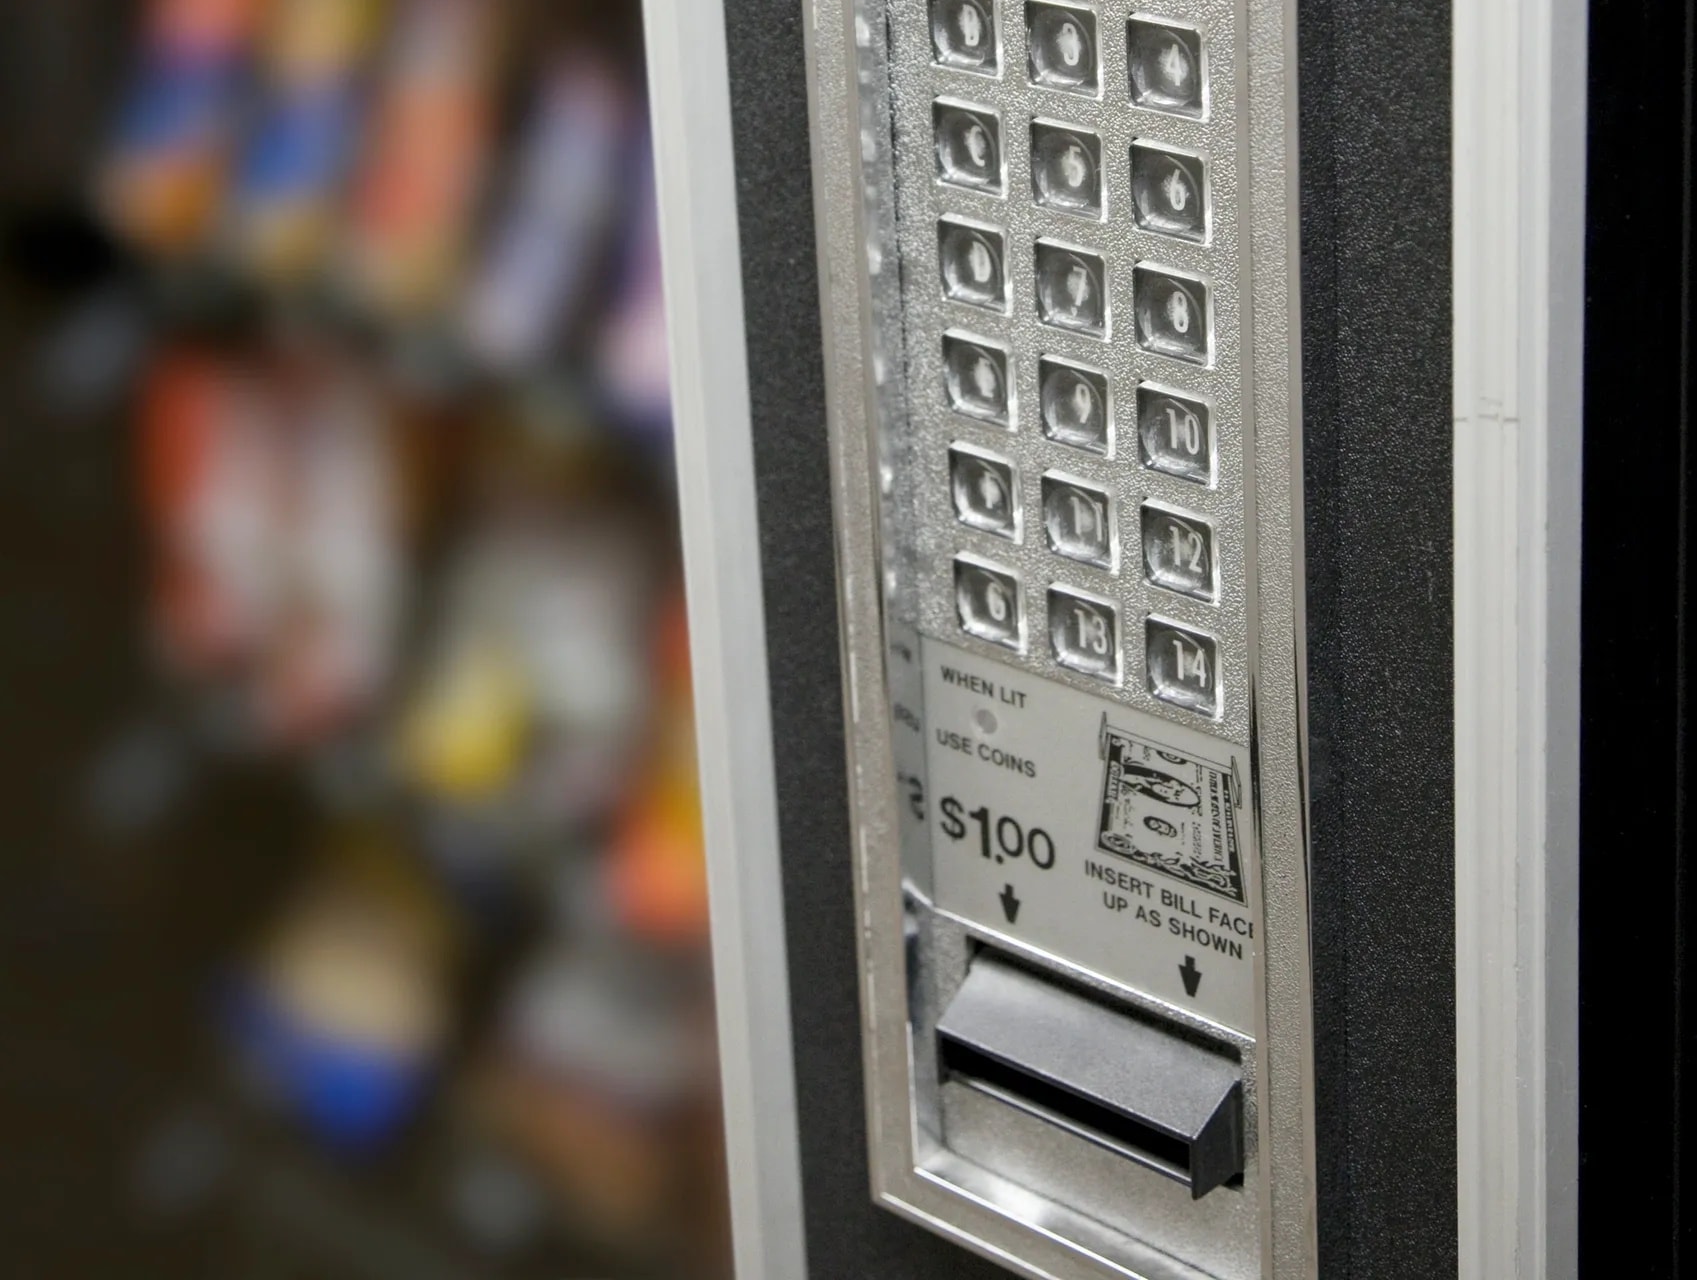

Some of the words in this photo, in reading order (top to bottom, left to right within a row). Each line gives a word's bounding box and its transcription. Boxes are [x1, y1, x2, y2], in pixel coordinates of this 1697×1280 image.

[1166, 43, 1186, 87] 4
[1068, 145, 1086, 188] 5
[1168, 168, 1186, 211] 6
[1171, 291, 1189, 333] 8
[1075, 383, 1092, 423] 9
[1166, 408, 1200, 455] 10
[1070, 496, 1104, 542] 11
[1169, 525, 1203, 574] 12
[1073, 608, 1108, 655] 13
[1173, 639, 1207, 688] 14
[940, 665, 995, 699] WHEN
[999, 687, 1027, 710] LIT
[936, 729, 973, 756] USE
[977, 742, 1037, 779] COINS
[940, 795, 1056, 870] $1.00
[1085, 859, 1155, 899] INSERT
[1161, 888, 1203, 919] BILL
[1103, 891, 1128, 912] UP
[1135, 905, 1162, 928] AS
[1168, 917, 1243, 960] SHOWN
